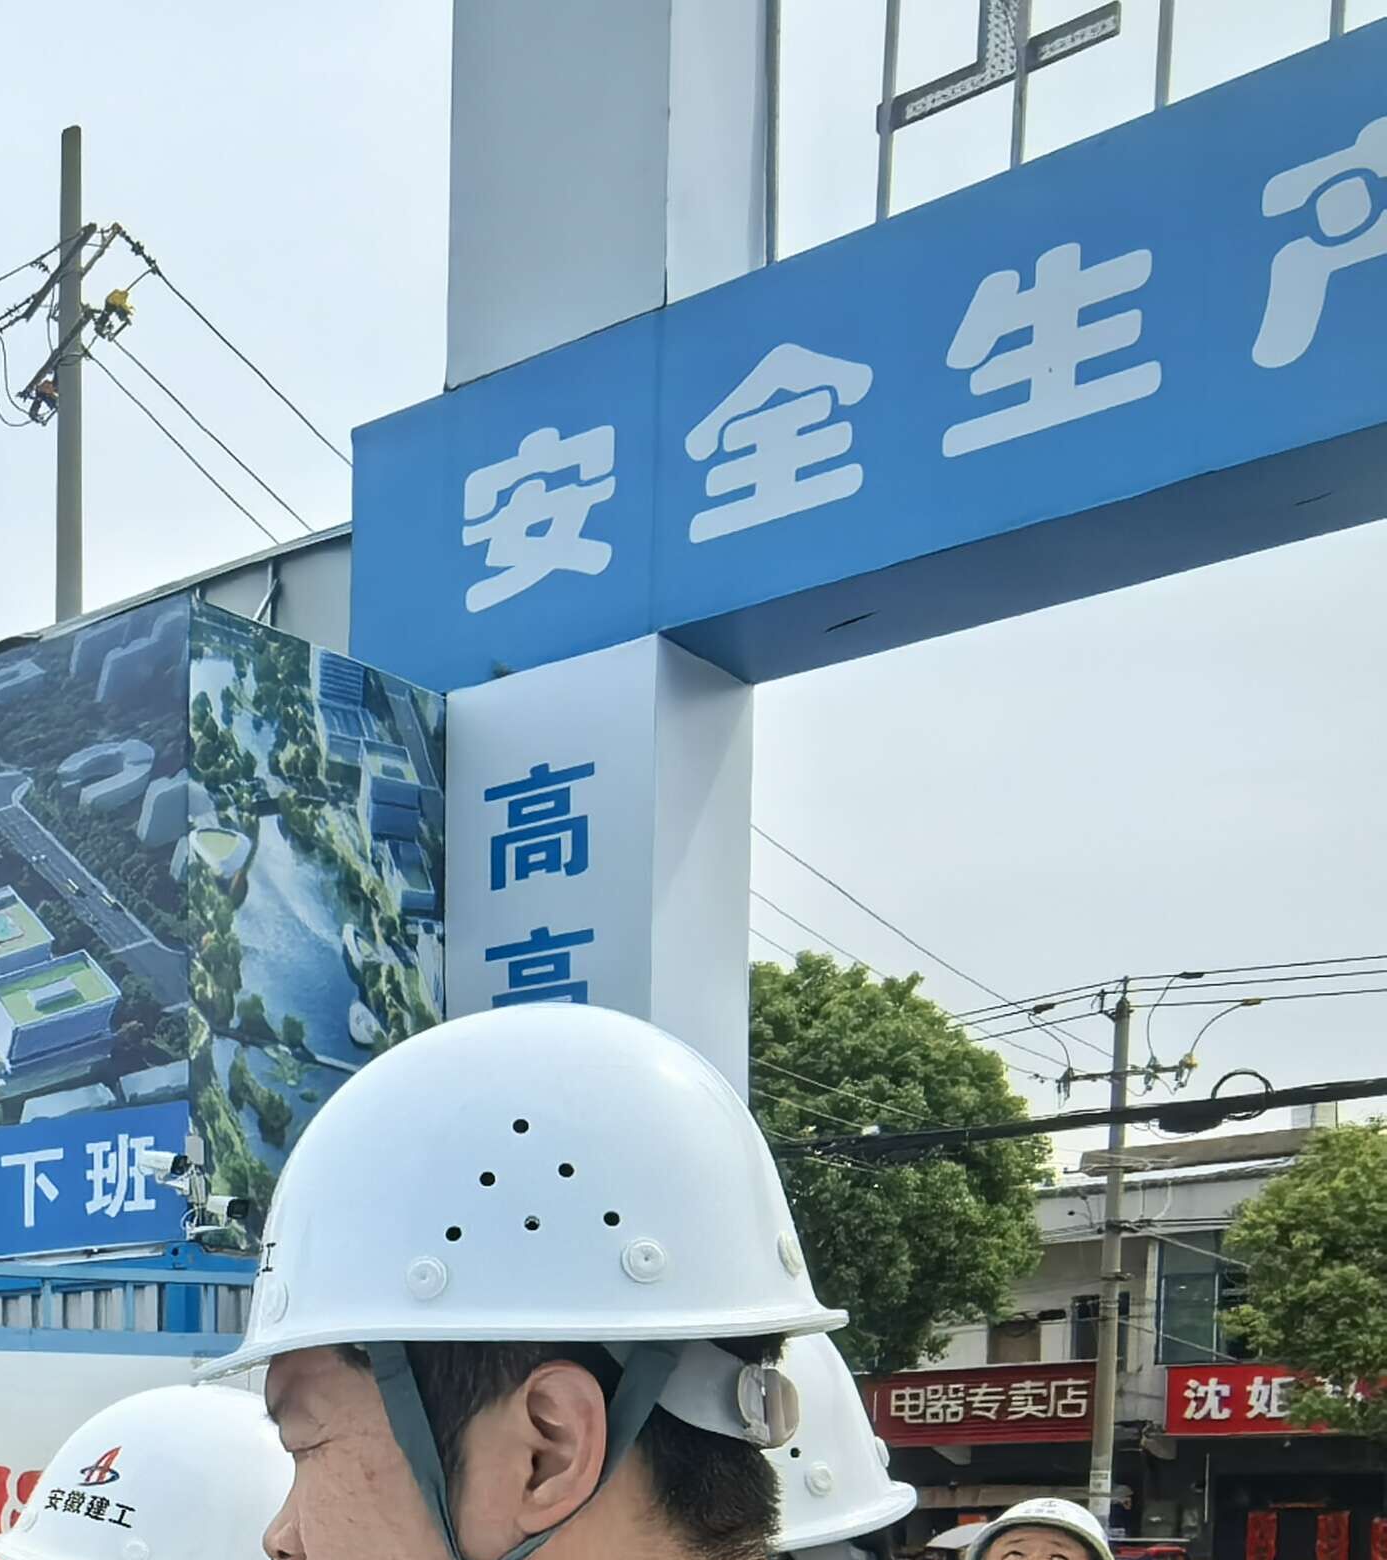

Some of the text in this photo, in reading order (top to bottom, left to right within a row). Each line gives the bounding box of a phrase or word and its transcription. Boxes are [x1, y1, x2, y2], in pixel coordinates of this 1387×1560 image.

[462, 116, 1387, 614] 安全生产
[483, 760, 596, 1008] 高高
[890, 1378, 1090, 1424] 电器专卖店
[44, 1488, 136, 1529] 安徽建工
